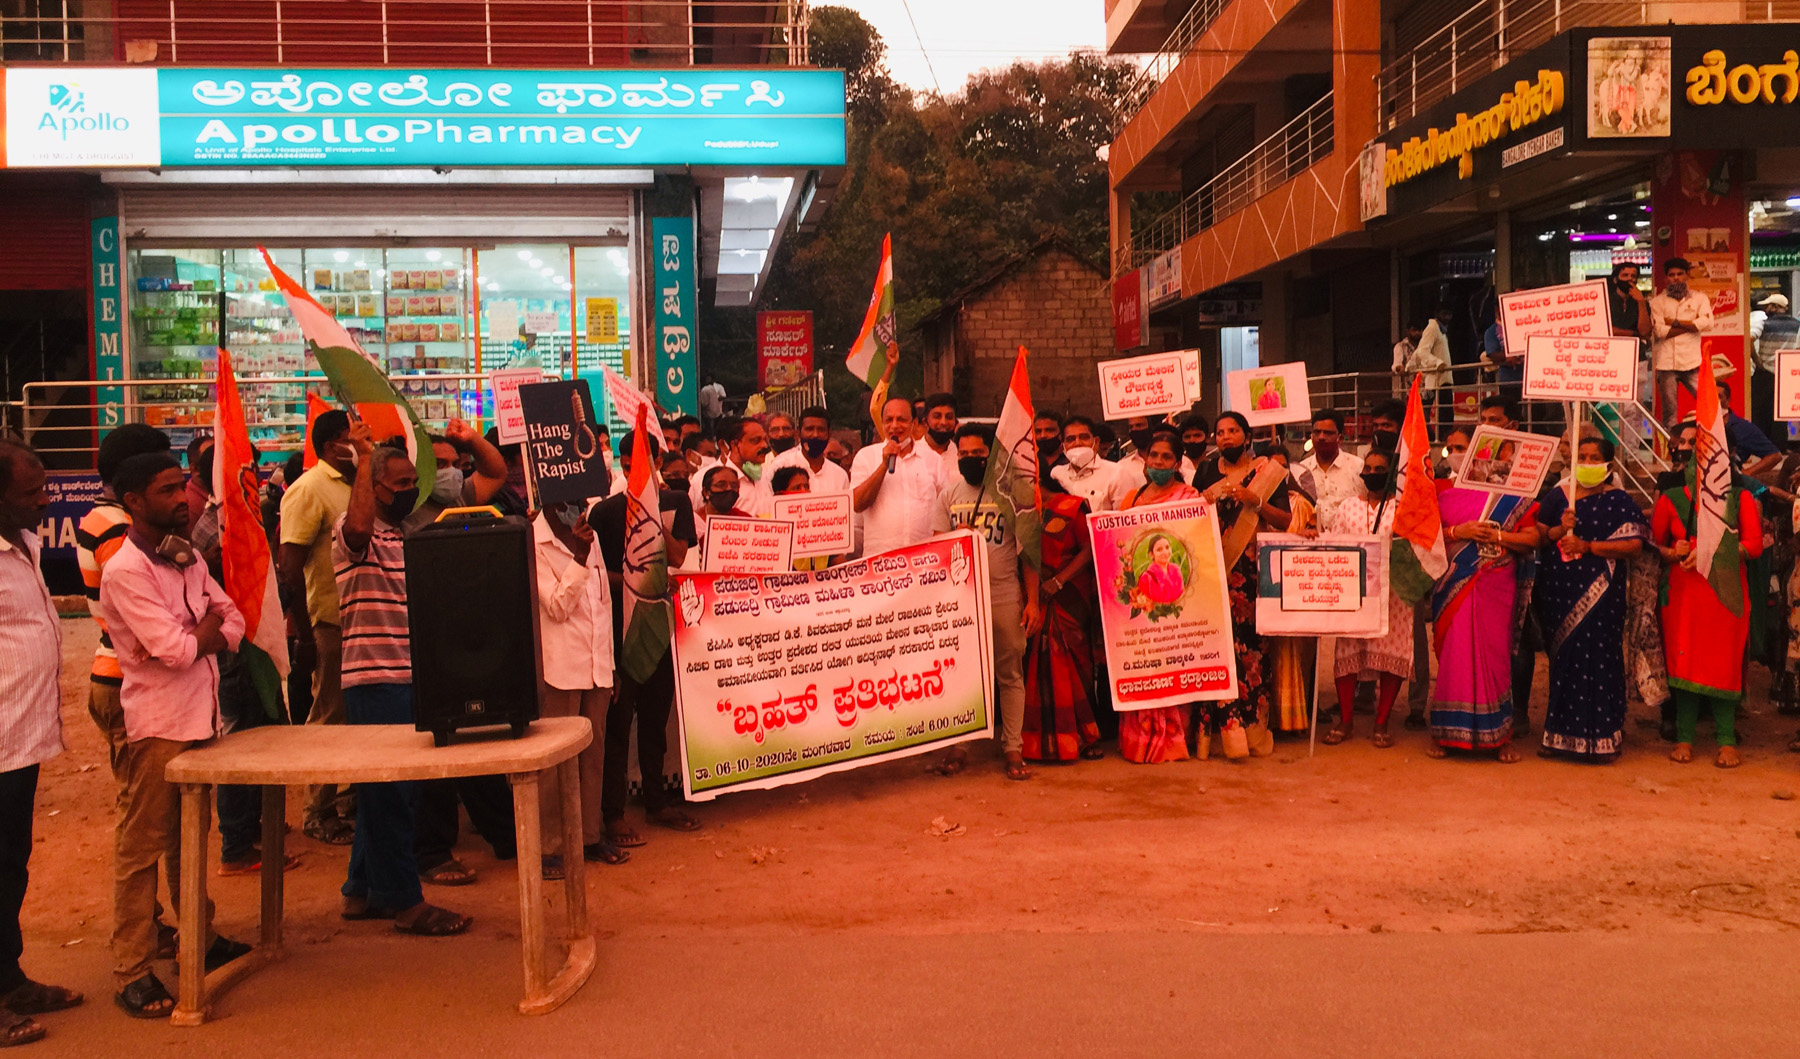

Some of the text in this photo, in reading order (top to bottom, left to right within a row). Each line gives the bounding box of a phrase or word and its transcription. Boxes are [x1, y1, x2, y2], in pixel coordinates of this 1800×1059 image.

[192, 74, 513, 112] ಅಪೋಲೋ
[38, 112, 129, 141] Apollo
[99, 228, 119, 426] CHEMIS
[528, 423, 572, 441] Hang
[532, 442, 564, 459] The
[537, 458, 587, 480] Rapist
[1097, 505, 1207, 530] JUSTICE FOR MANISHA
[714, 573, 760, 595] ಪಡುಬಿದ್ರಿ
[763, 571, 810, 593] ಗ್ರಾಮೀಣ
[873, 554, 908, 573] ಸಮಿತಿ
[912, 553, 940, 567] ಹಾಗೂ
[714, 598, 760, 617] ಪಡುಬಿದ್ರಿ
[764, 591, 811, 612] ಗ್ರಾಮೀಣ
[815, 584, 856, 602] ಮಹಿಳಾ
[919, 568, 948, 585] ಸಮಿತಿ
[857, 615, 872, 629] ಮನೆ
[876, 611, 895, 625] ಮೇಲೆ
[757, 650, 782, 666] ಉತ್ತರ
[821, 640, 842, 652] ದಲಿತ
[845, 632, 883, 648] ಯುವತಿಯ
[886, 627, 910, 640] ಮೇಲಿನ
[827, 656, 853, 669] ಯೋಗಿ
[1119, 675, 1175, 695] ಭಾವಪೂರ್ಣ
[801, 738, 851, 759] ಮಂಗಳವಾರ
[864, 729, 895, 746] ಸಮಯ
[906, 721, 925, 737] ಸಂಜೆ
[929, 717, 950, 731] 6.00
